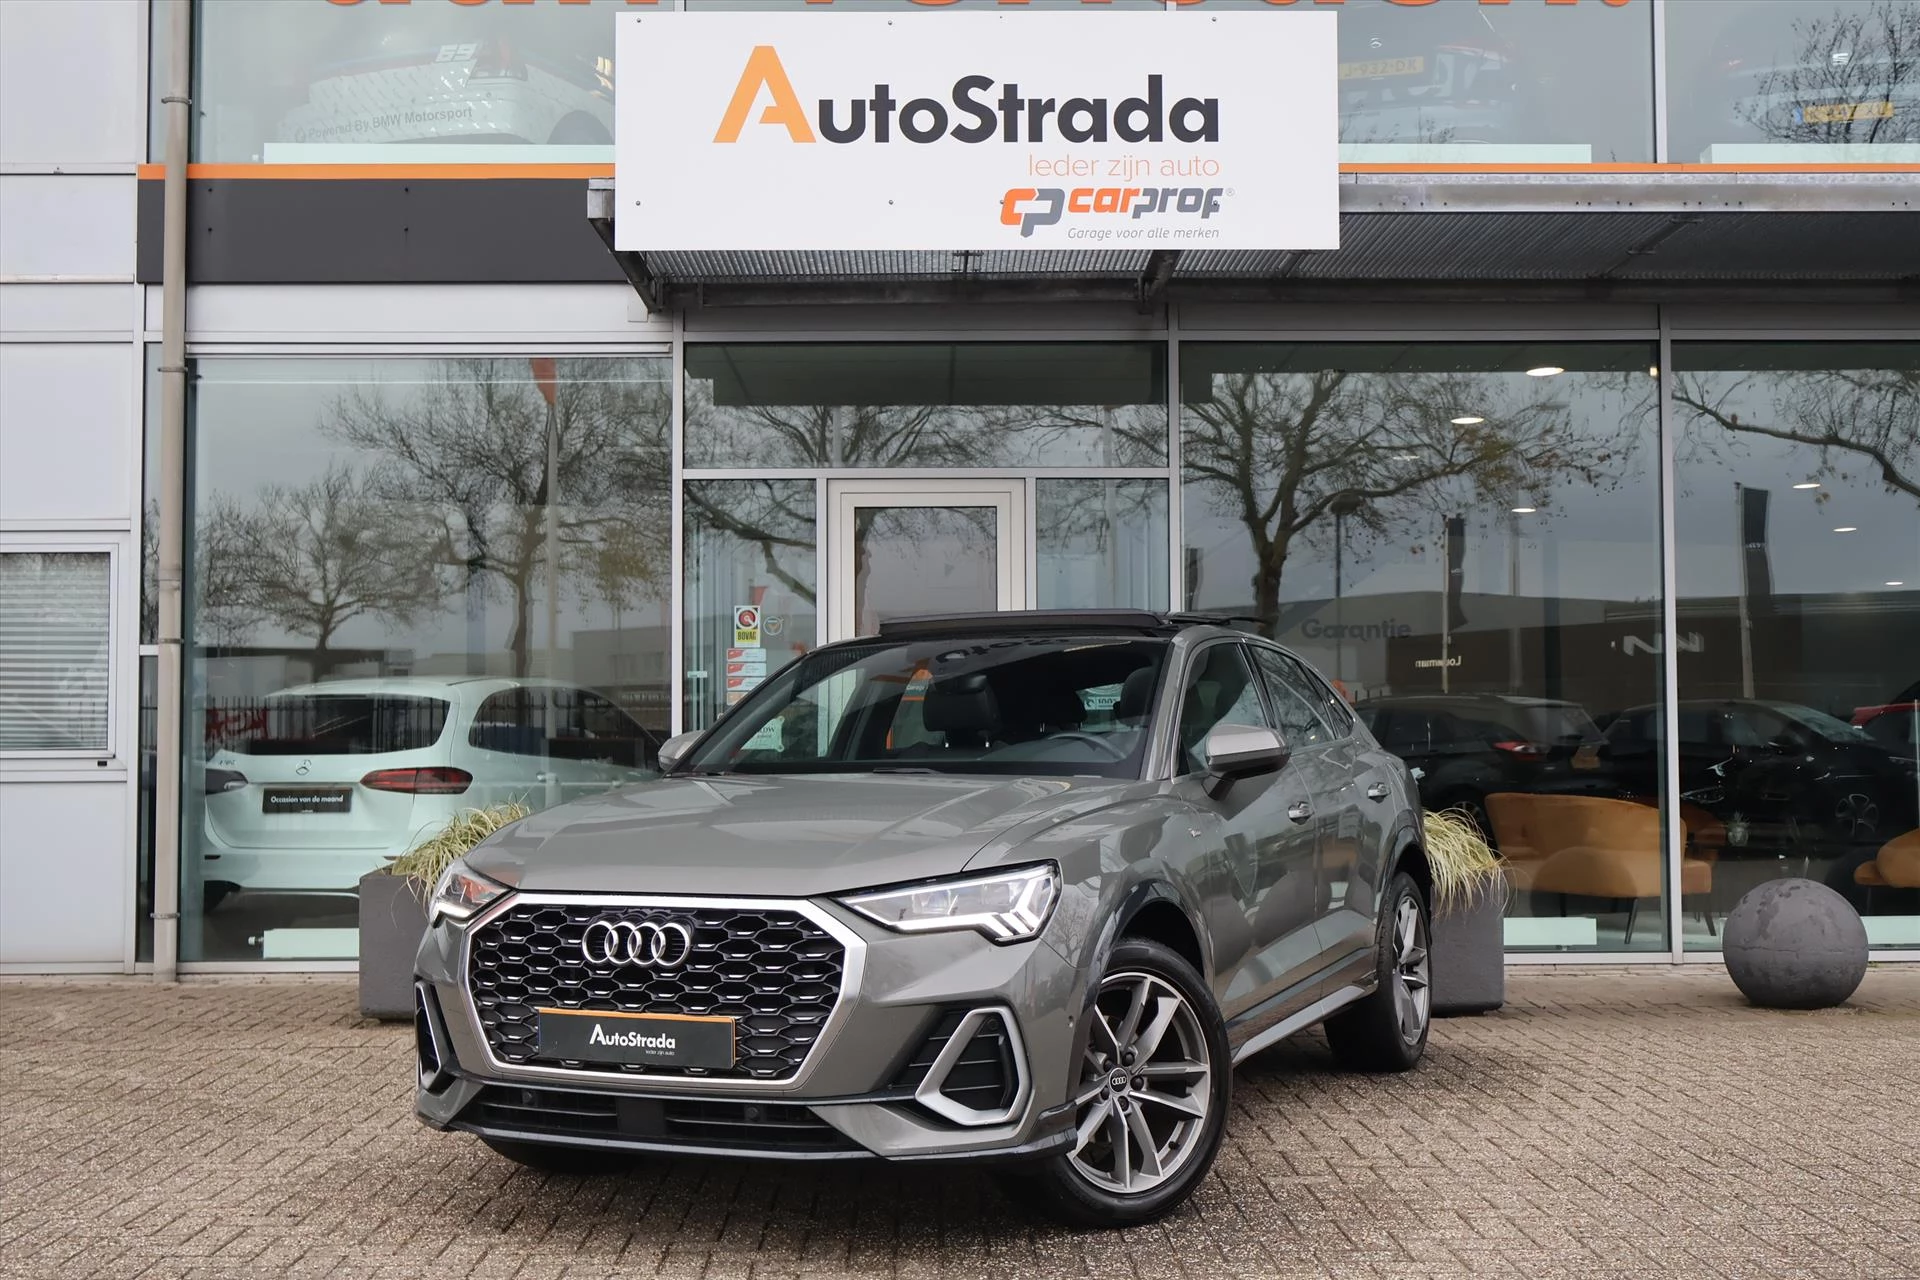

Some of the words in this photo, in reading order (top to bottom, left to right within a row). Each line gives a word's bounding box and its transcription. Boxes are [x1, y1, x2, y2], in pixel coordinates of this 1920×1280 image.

[713, 46, 1220, 145] AutoStrada
[308, 122, 351, 139] Powered
[354, 119, 369, 132] By
[373, 114, 401, 129] BMW
[404, 106, 473, 124] Motorsport
[1029, 154, 1097, 177] Ieder
[1107, 155, 1150, 182] zijn
[1160, 155, 1220, 177] auto
[1068, 187, 1224, 220] carprof
[1067, 227, 1111, 242] Garage
[1116, 229, 1144, 239] voor
[1147, 227, 1171, 239] alle
[1174, 227, 1220, 239] merken
[737, 631, 757, 641] BOVAG
[1301, 618, 1412, 640] Garantie
[270, 795, 298, 803] Occasion
[312, 795, 320, 803] de
[321, 794, 344, 803] maand
[589, 1023, 676, 1050] AutoStrada
